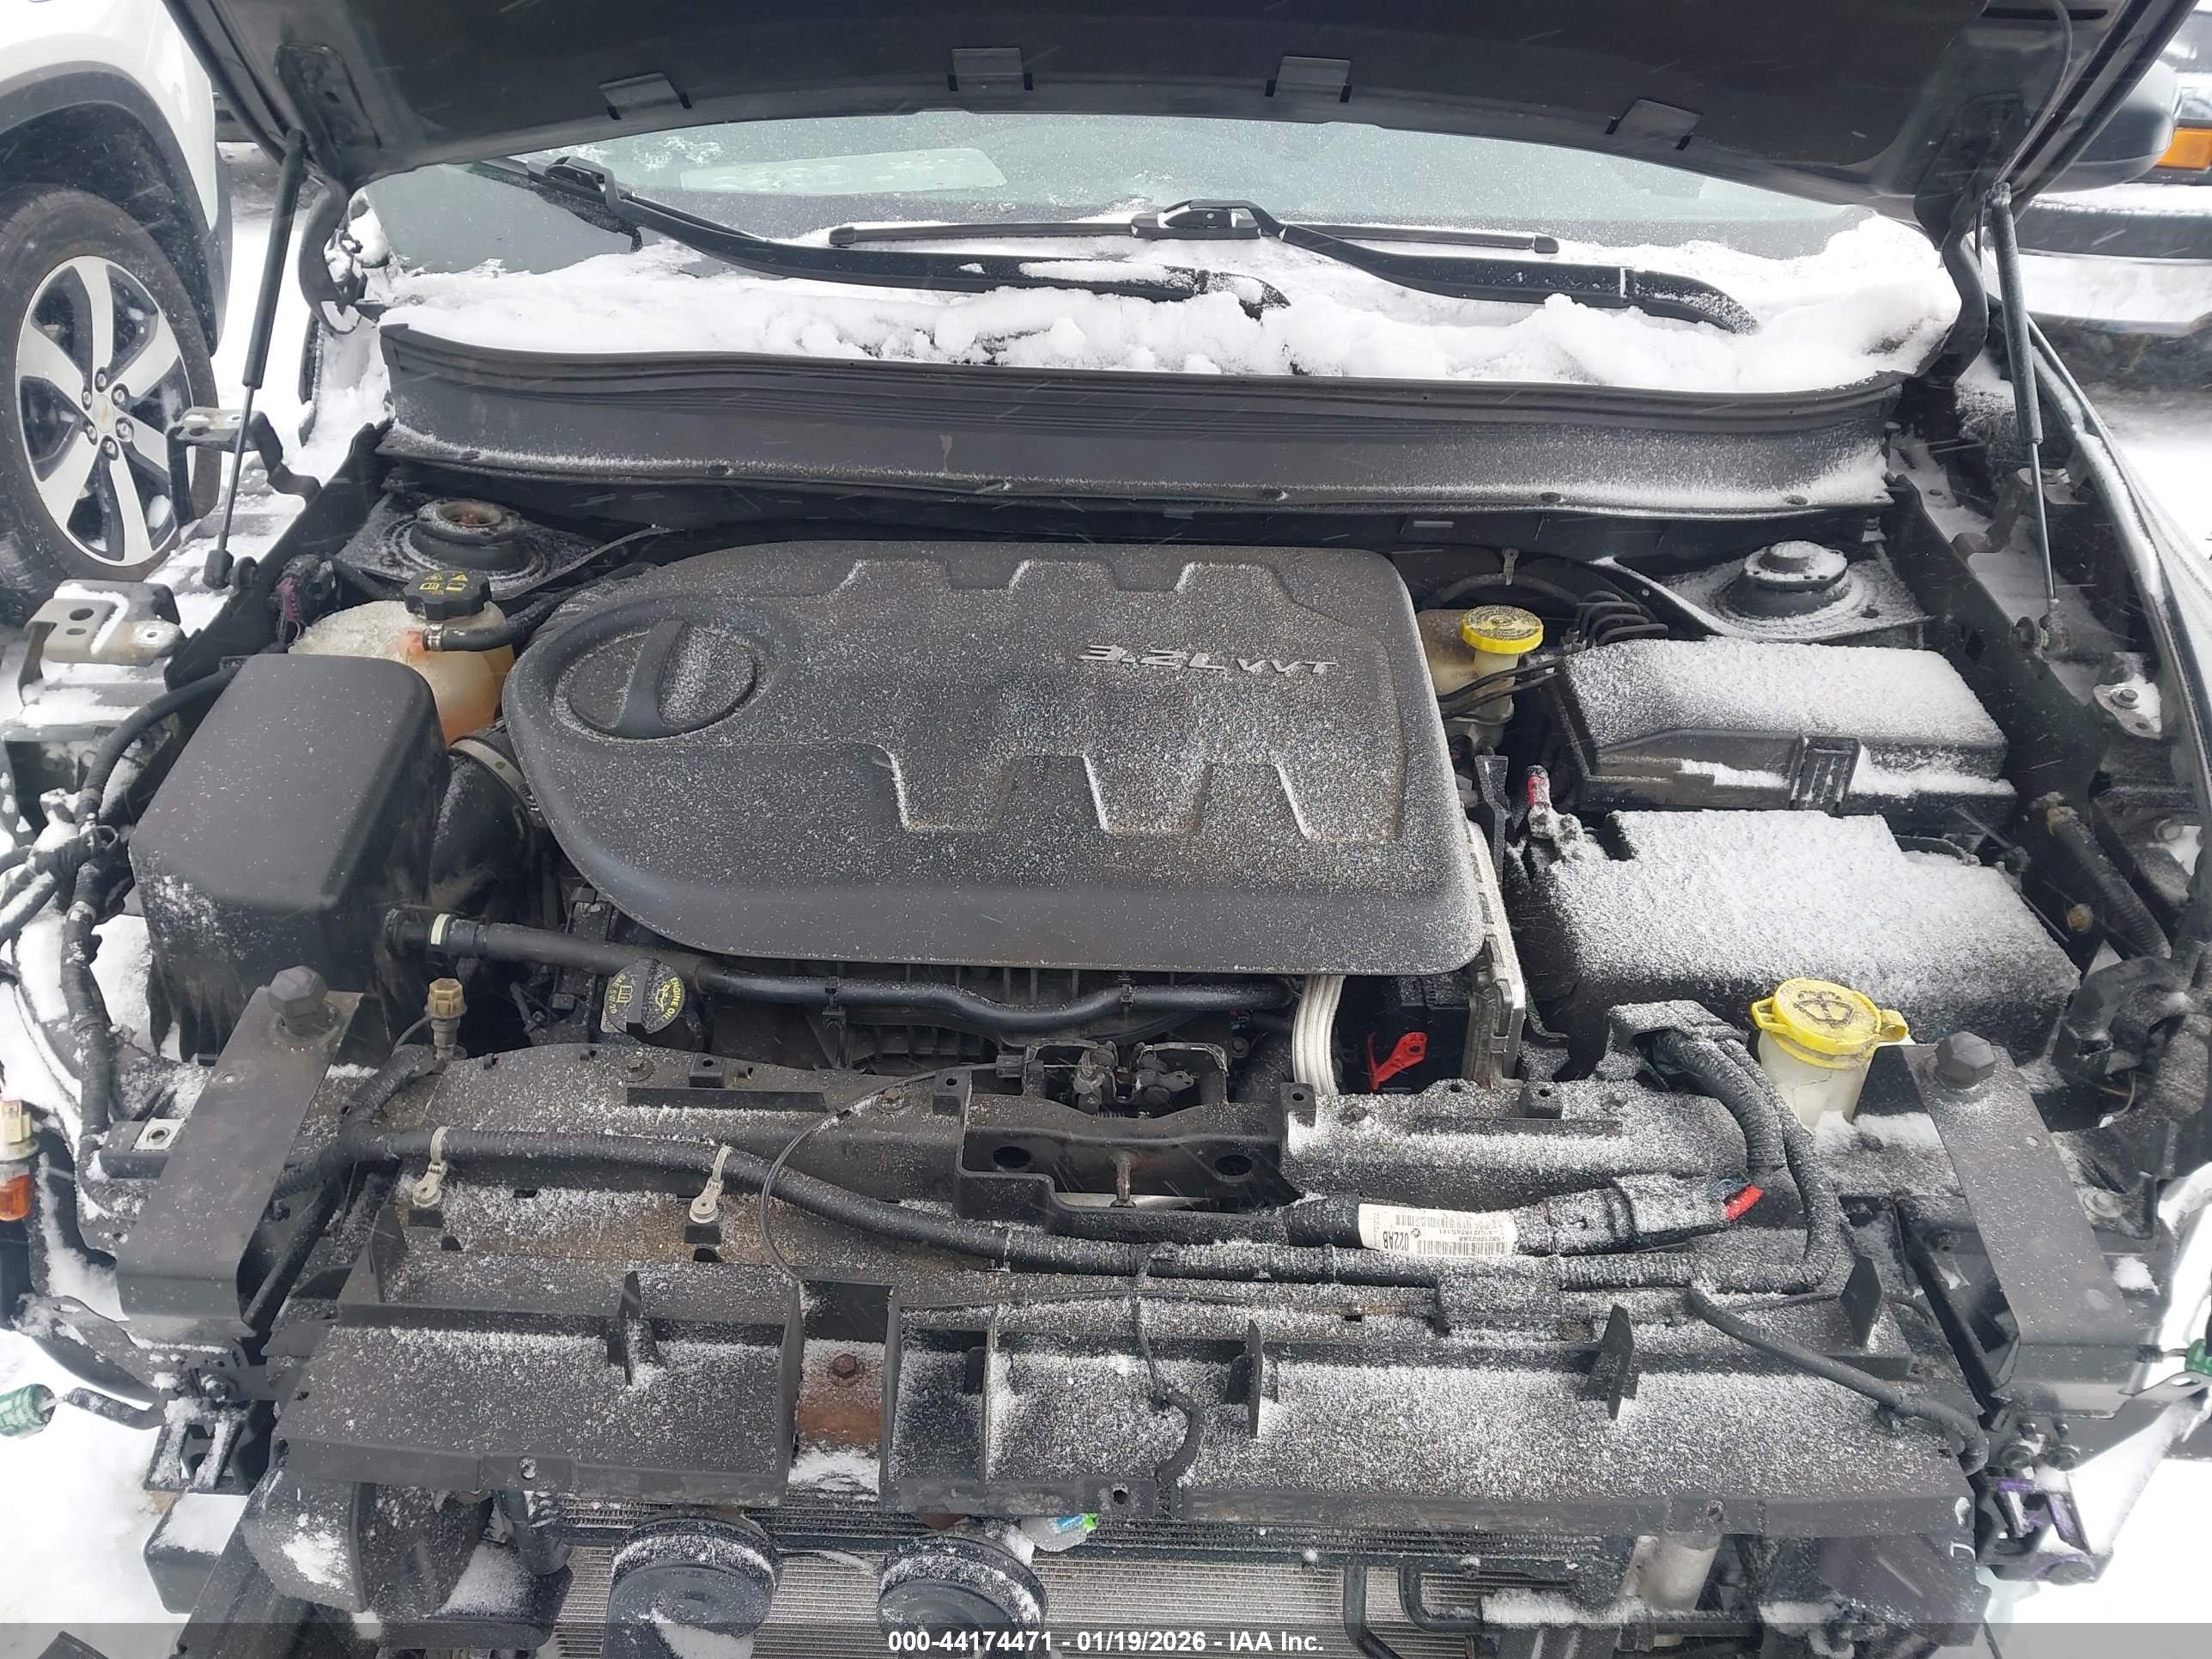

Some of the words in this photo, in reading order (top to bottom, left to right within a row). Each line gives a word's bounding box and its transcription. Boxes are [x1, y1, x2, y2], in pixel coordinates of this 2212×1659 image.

[1077, 644, 1226, 671] 3.2L
[1237, 659, 1339, 675] VVT
[612, 973, 626, 989] SAE
[669, 976, 681, 1007] ENGINE
[660, 1008, 676, 1022] OIL
[1382, 1231, 1409, 1251] 022AB
